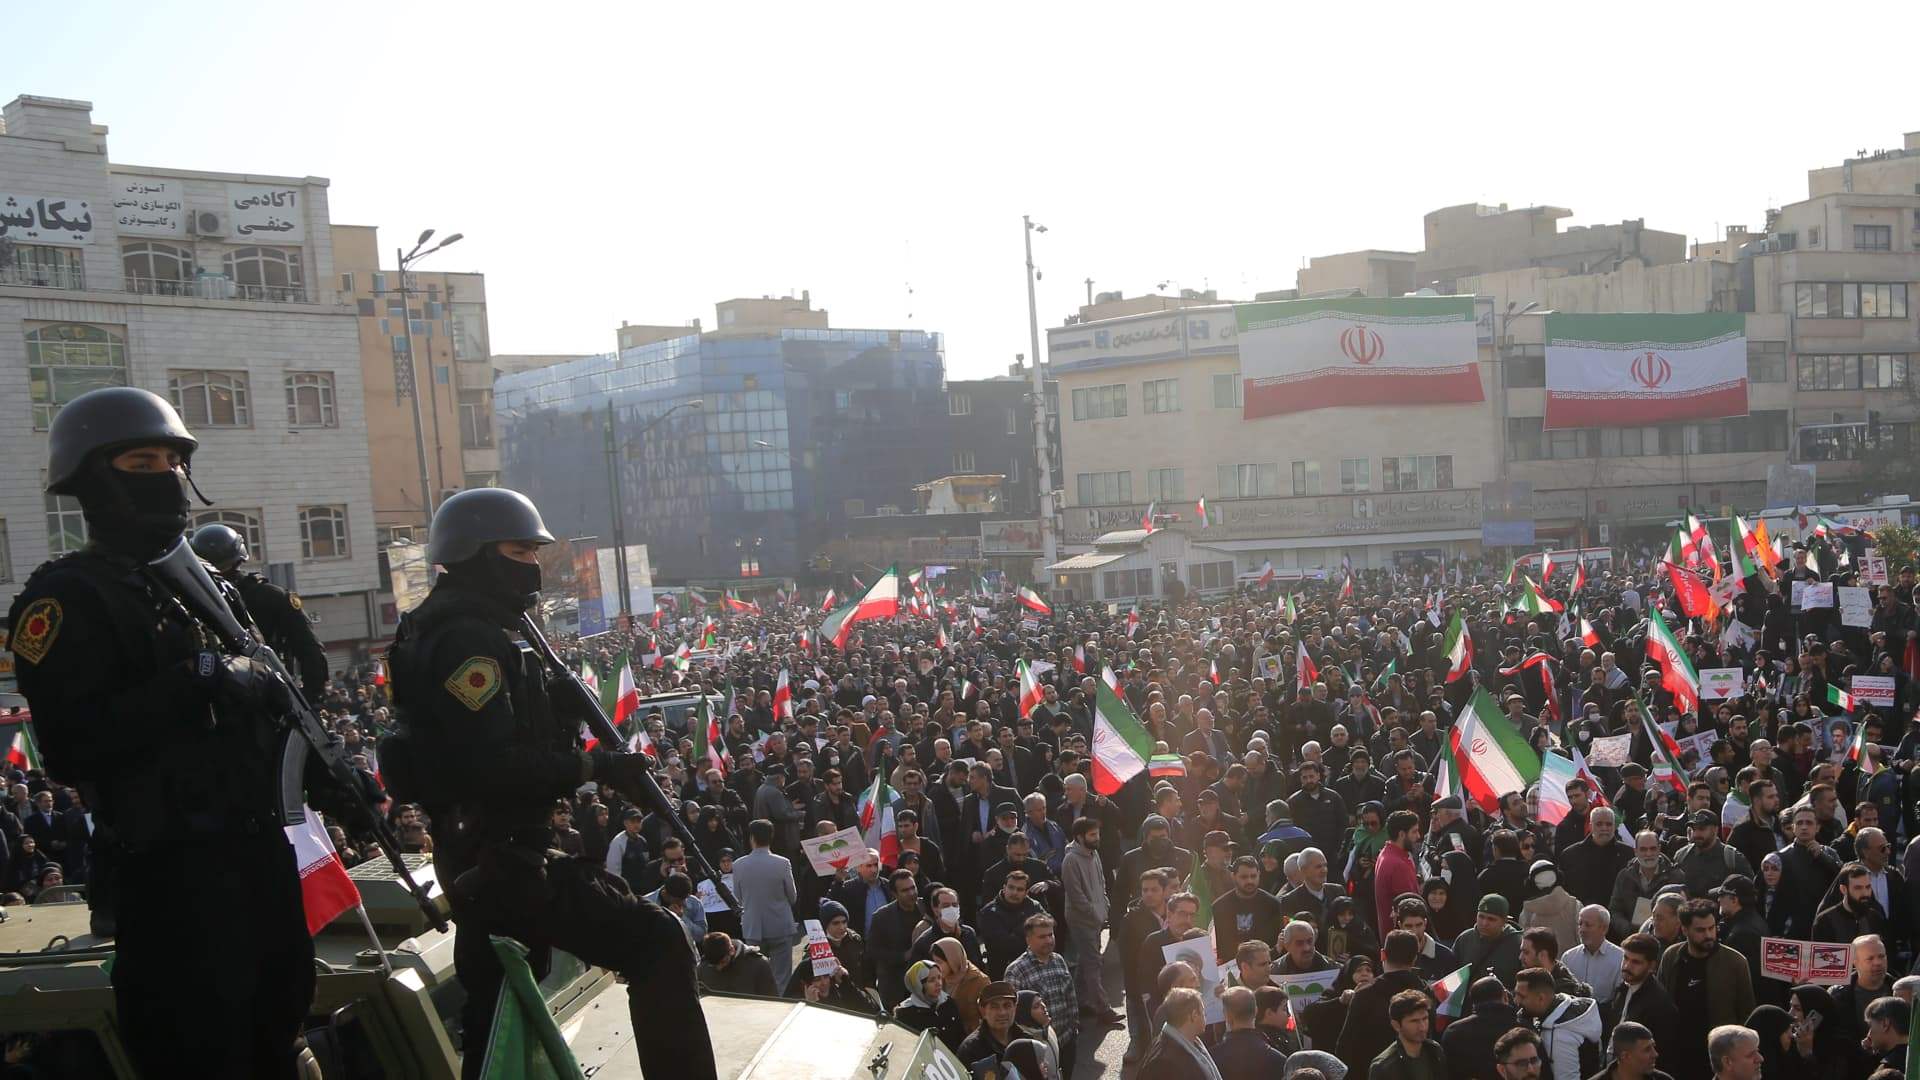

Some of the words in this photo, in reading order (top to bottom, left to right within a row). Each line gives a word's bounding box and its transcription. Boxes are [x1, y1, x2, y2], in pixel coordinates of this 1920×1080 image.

[126, 182, 165, 195] آموزش
[113, 199, 138, 208] دستی
[141, 200, 181, 212] الگوسازی
[234, 191, 297, 210] آکادمی
[119, 215, 168, 227] کامپیوتری
[237, 217, 295, 234] حنفی
